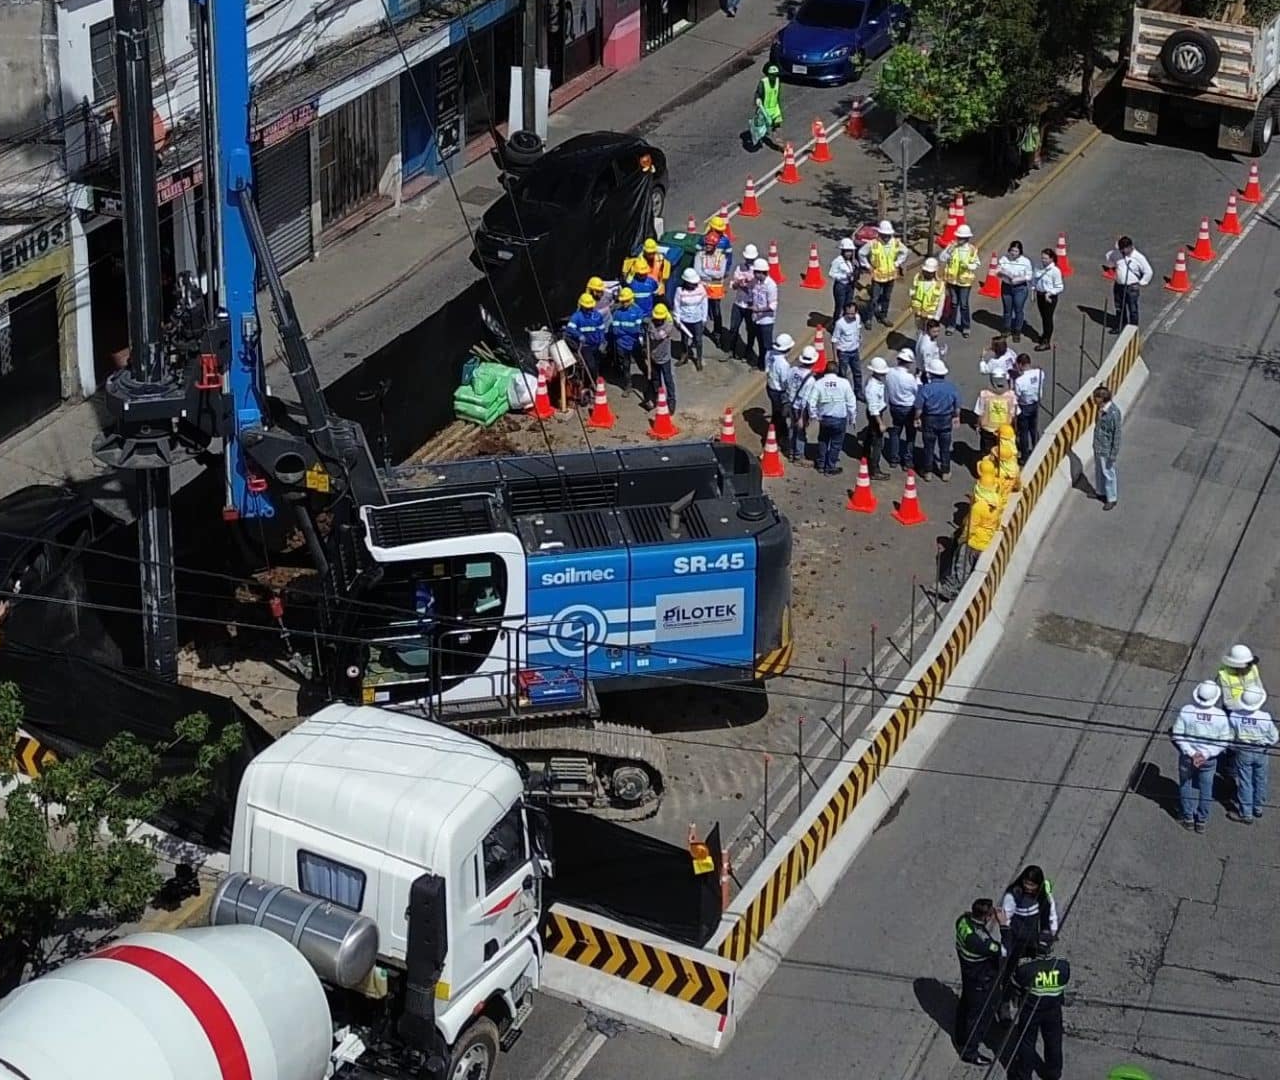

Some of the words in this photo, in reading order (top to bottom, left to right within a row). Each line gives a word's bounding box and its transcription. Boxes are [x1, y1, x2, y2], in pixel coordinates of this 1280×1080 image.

[541, 566, 615, 586] soilmec
[673, 552, 745, 575] SR-45
[663, 603, 737, 623] PILOTEK
[1034, 969, 1060, 987] PMT
